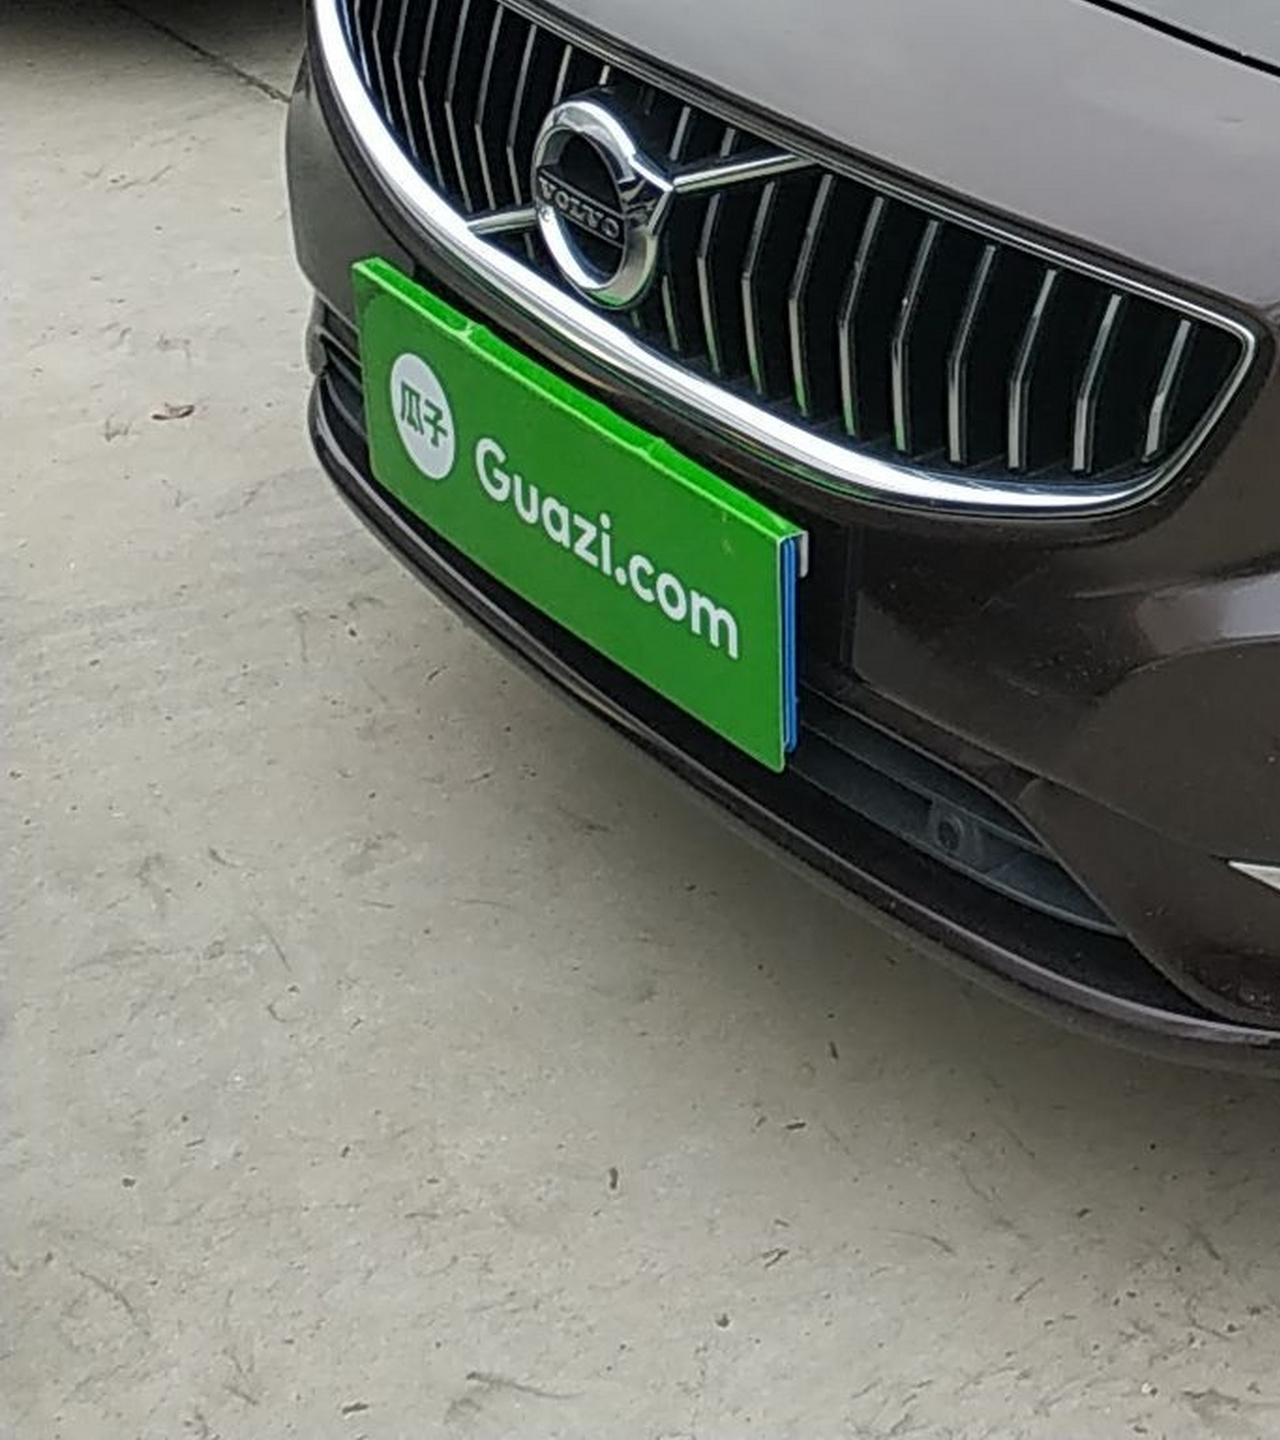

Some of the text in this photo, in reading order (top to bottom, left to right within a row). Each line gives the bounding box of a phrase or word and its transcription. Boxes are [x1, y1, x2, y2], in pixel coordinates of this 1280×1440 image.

[538, 175, 621, 240] VOLVO
[398, 380, 450, 449] 瓜子
[474, 436, 740, 661] Guazi.com
